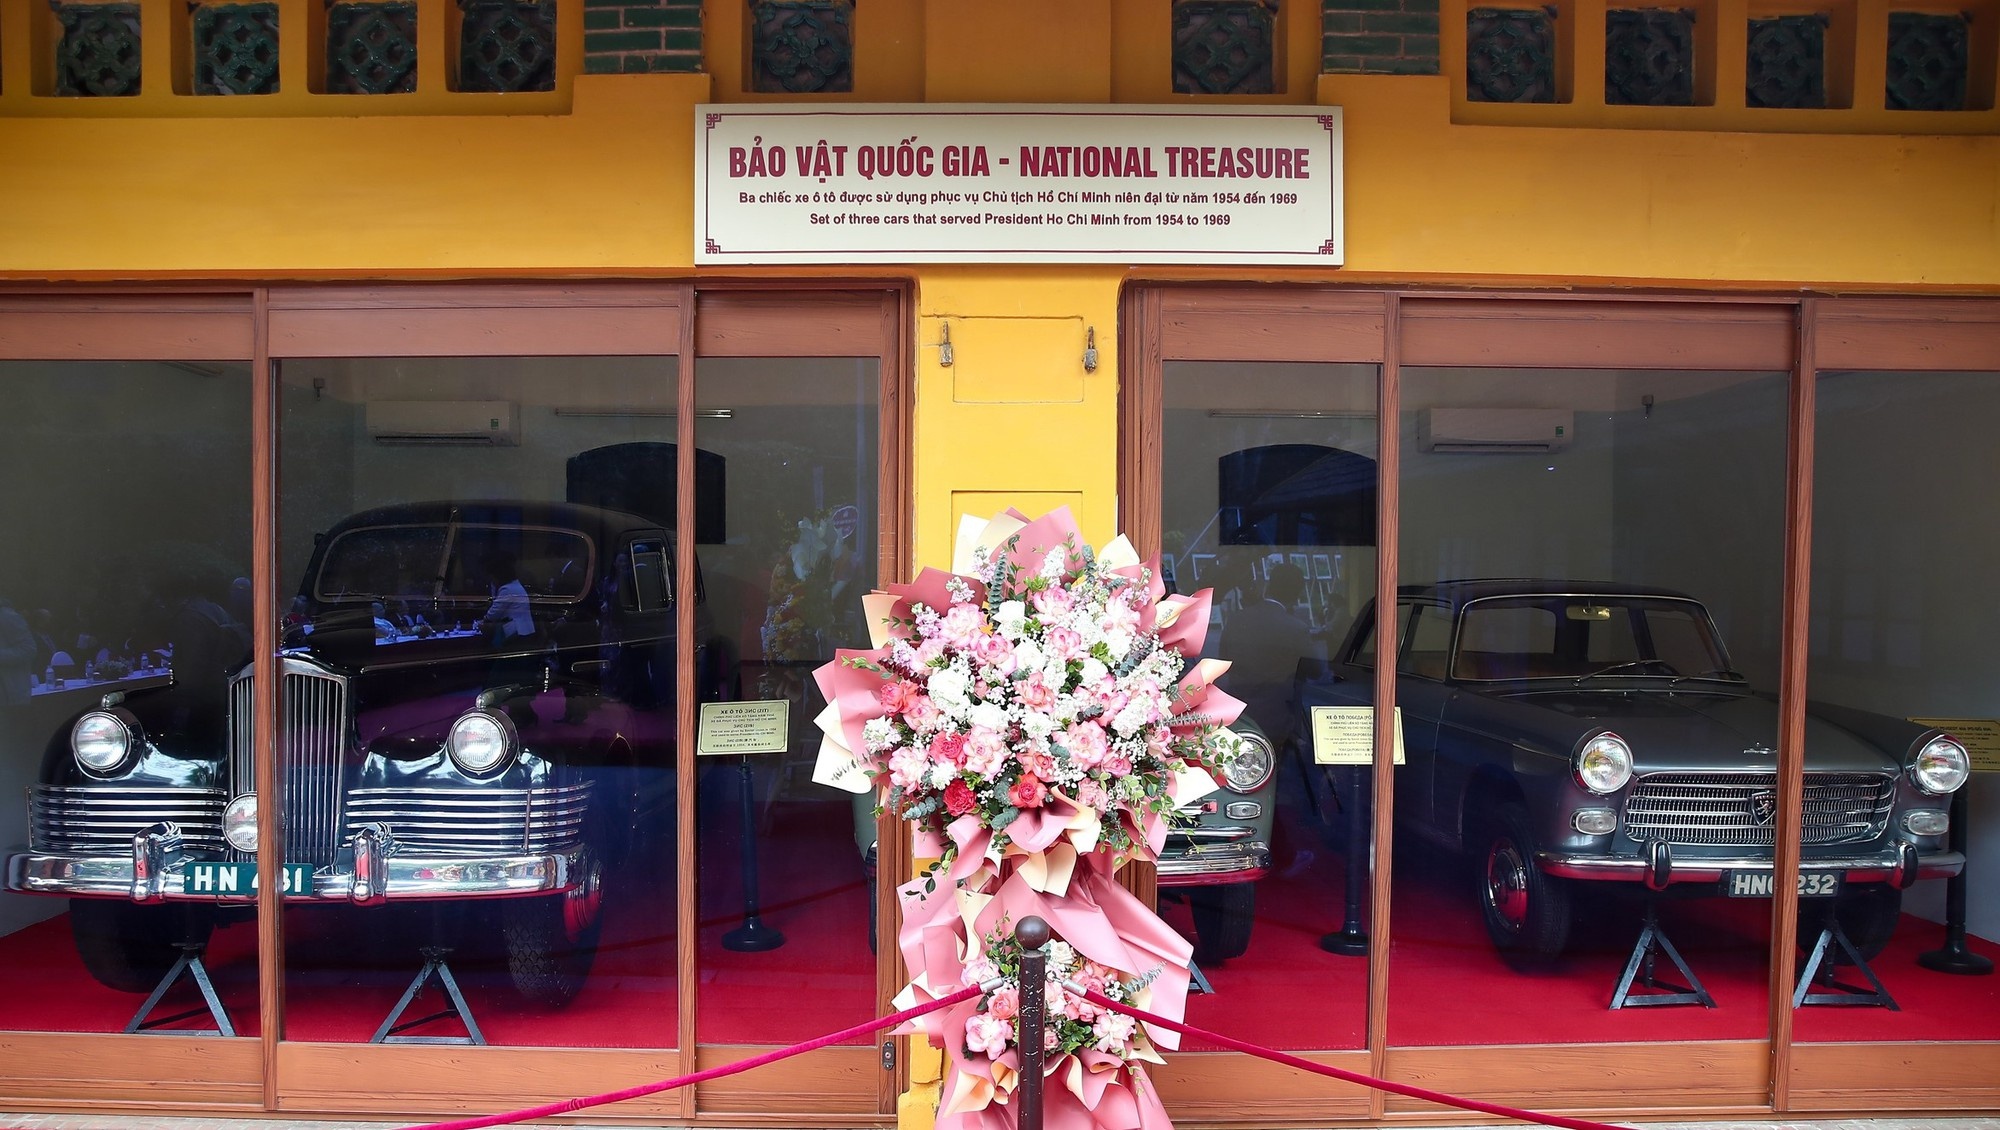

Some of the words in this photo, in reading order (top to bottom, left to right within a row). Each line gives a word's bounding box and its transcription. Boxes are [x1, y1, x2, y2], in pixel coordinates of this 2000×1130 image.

[730, 136, 785, 177] BẢO
[796, 140, 848, 183] VẬT
[858, 136, 933, 180] QUỐC
[942, 146, 990, 177] GIA
[1020, 146, 1157, 177] NATIONAL
[1165, 147, 1309, 179] TREASURE
[740, 192, 755, 203] Ba
[759, 191, 791, 203] chiếc
[795, 194, 809, 203] xe
[813, 192, 820, 203] ô
[823, 191, 836, 203] tô
[840, 191, 872, 205] được
[896, 191, 926, 205] dụng
[931, 191, 960, 205] phục
[964, 193, 979, 205] vụ
[983, 191, 1007, 203] Chủ
[1011, 191, 1033, 205] tịch
[1058, 191, 1078, 203] Chí
[1082, 192, 1110, 203] Minh
[1115, 192, 1140, 203] niên
[1144, 192, 1162, 205] đại
[1166, 192, 1179, 203] từ
[1183, 192, 1208, 203] năm
[1213, 192, 1240, 204] 1954
[1243, 191, 1265, 204] đến
[1270, 193, 1297, 204] 1969
[810, 213, 830, 224] Set
[833, 213, 845, 224] of
[849, 213, 880, 224] three
[884, 215, 909, 224] cars
[913, 213, 936, 224] that
[940, 213, 980, 224] served
[985, 213, 1043, 224] President
[1047, 213, 1063, 225] Ho
[1067, 214, 1087, 225] Chi
[1091, 214, 1120, 225] Minh
[1123, 214, 1151, 225] from
[1156, 214, 1183, 225] 1954
[1187, 215, 1199, 225] to
[1203, 214, 1230, 225] 1969
[194, 866, 238, 891] HN
